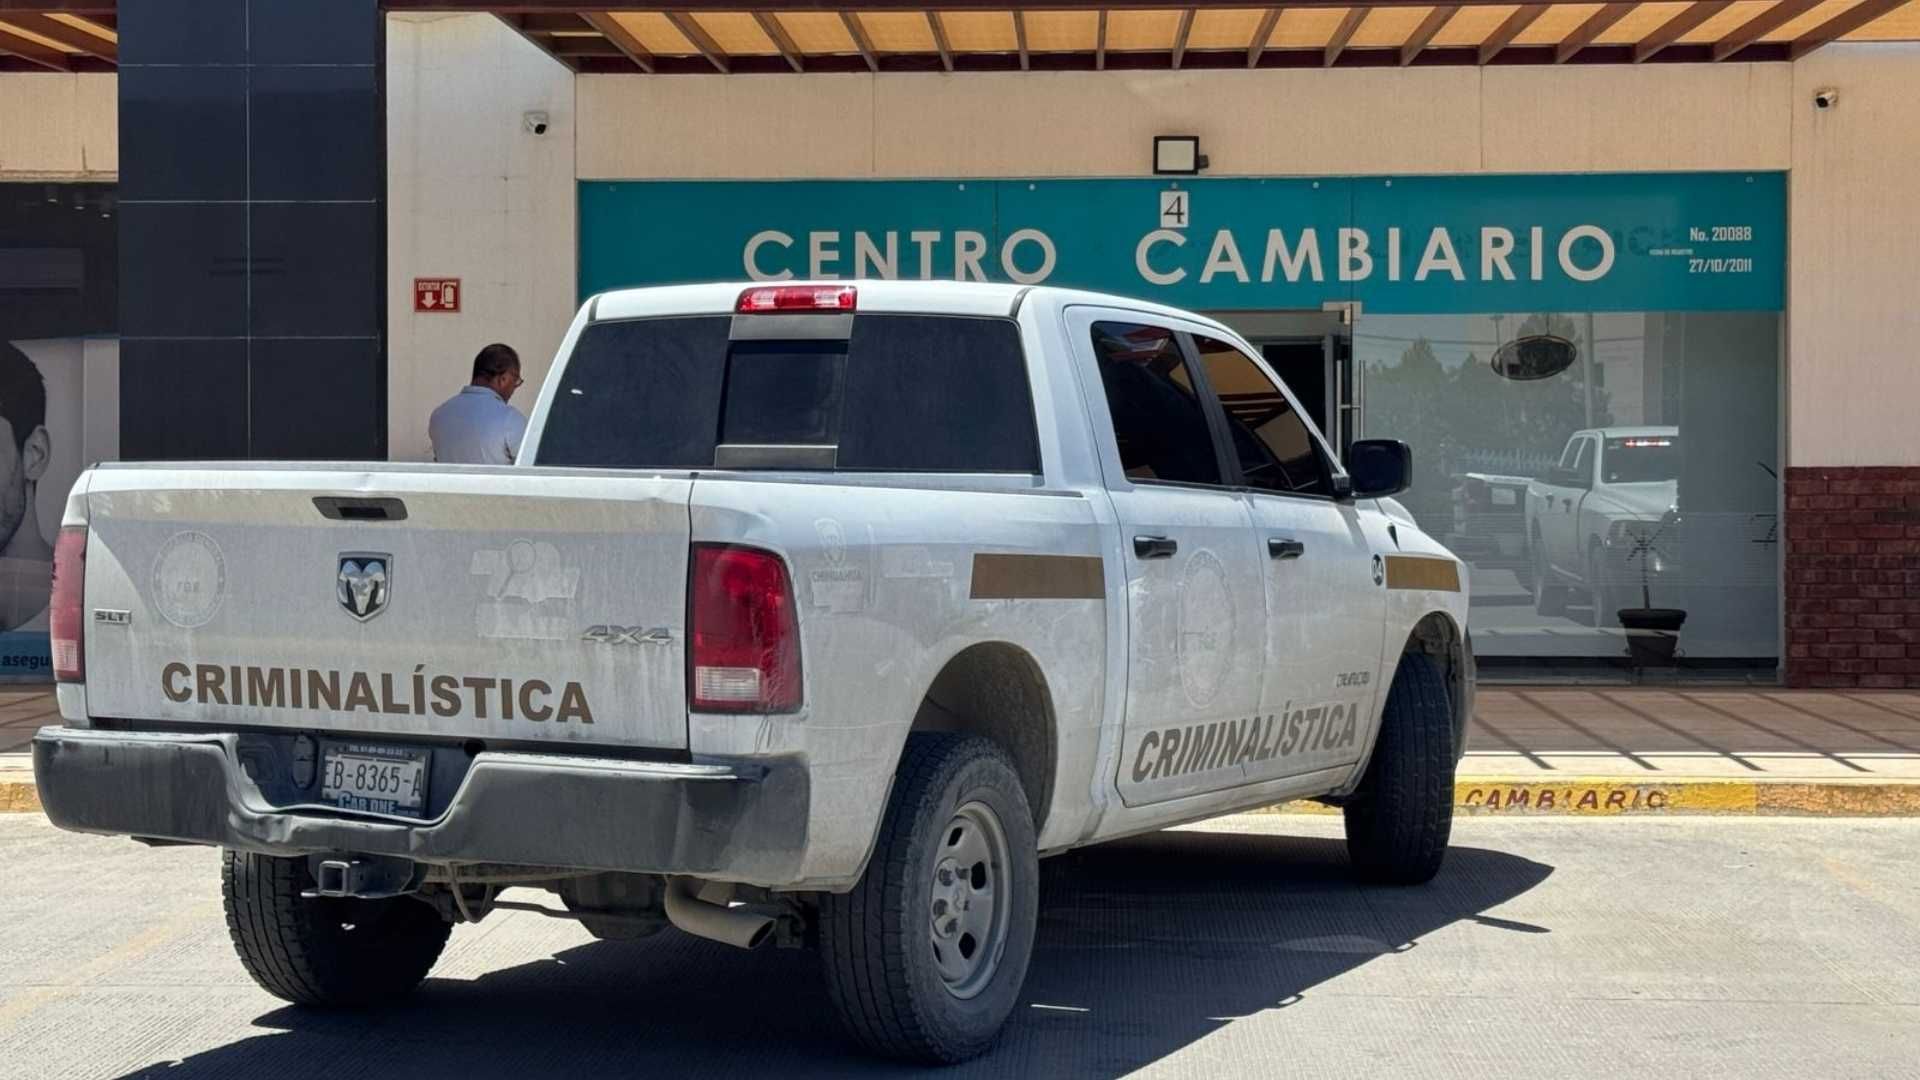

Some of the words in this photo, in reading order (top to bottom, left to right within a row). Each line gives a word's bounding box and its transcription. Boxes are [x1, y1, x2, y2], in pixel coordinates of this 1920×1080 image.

[1163, 195, 1185, 225] 4
[1689, 227, 1709, 242] No.
[1711, 226, 1752, 242] 20088
[743, 228, 1057, 284] CENTRO
[1135, 224, 1615, 286] CAMBIARIO
[1688, 258, 1752, 273] 27/10/2011
[95, 610, 127, 621] SLT
[1, 655, 49, 670] asegu
[162, 661, 595, 725] CRIMINALÍSTICA
[1132, 700, 1358, 783] CRIMINALÍSTICA
